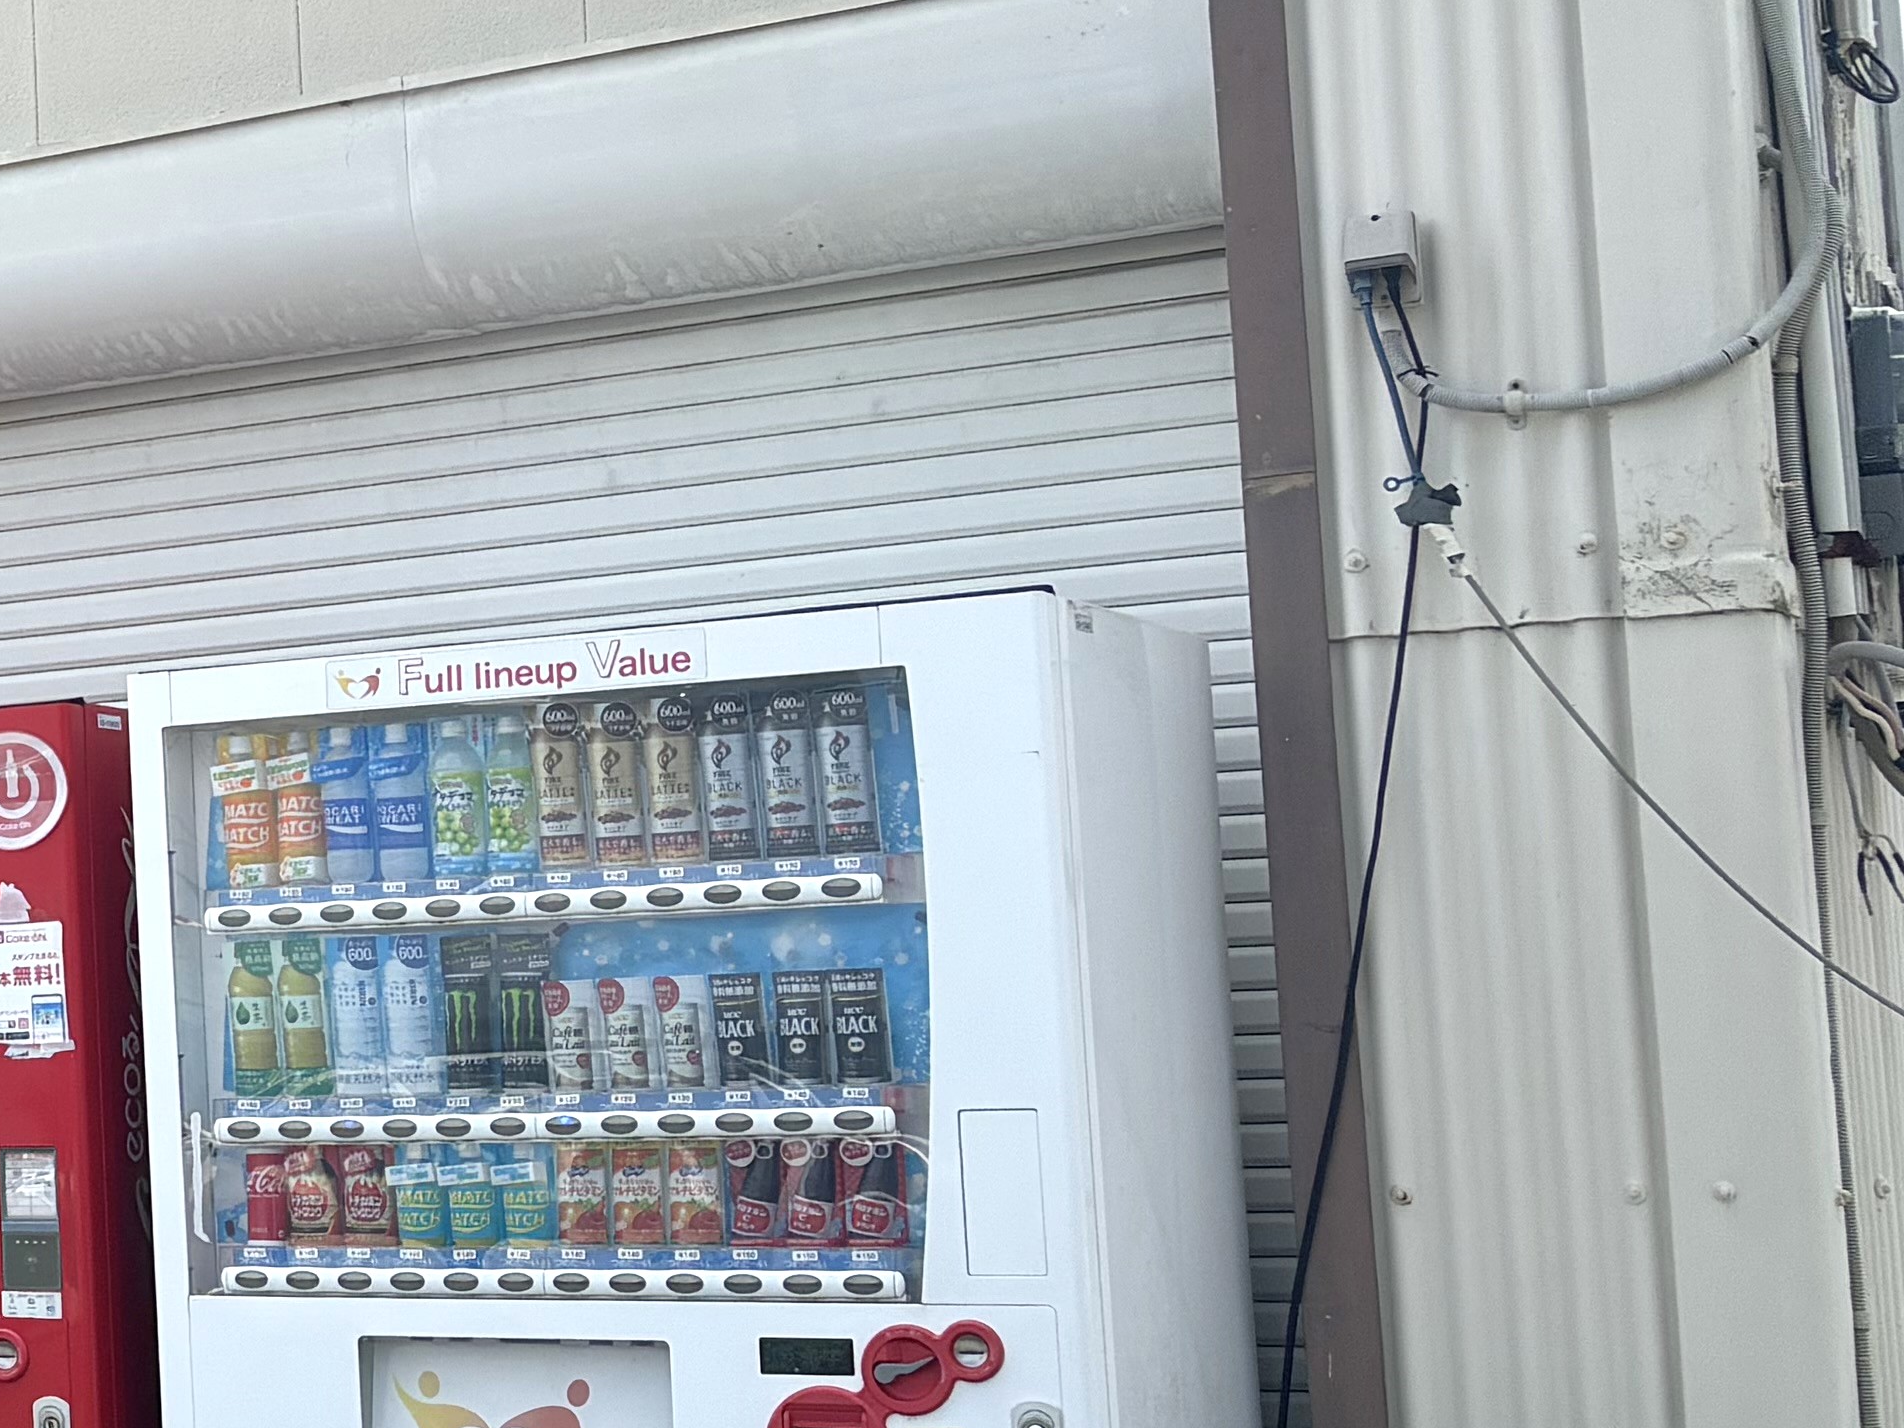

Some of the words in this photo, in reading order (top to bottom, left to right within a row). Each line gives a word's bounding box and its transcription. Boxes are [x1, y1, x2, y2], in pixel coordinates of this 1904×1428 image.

[397, 657, 463, 696] Full
[475, 659, 578, 690] lineup
[586, 639, 692, 678] Value
[347, 948, 372, 961] 600
[719, 1019, 756, 1038] BLACK
[779, 1017, 820, 1036] BLACK
[836, 1015, 878, 1034] BLACK
